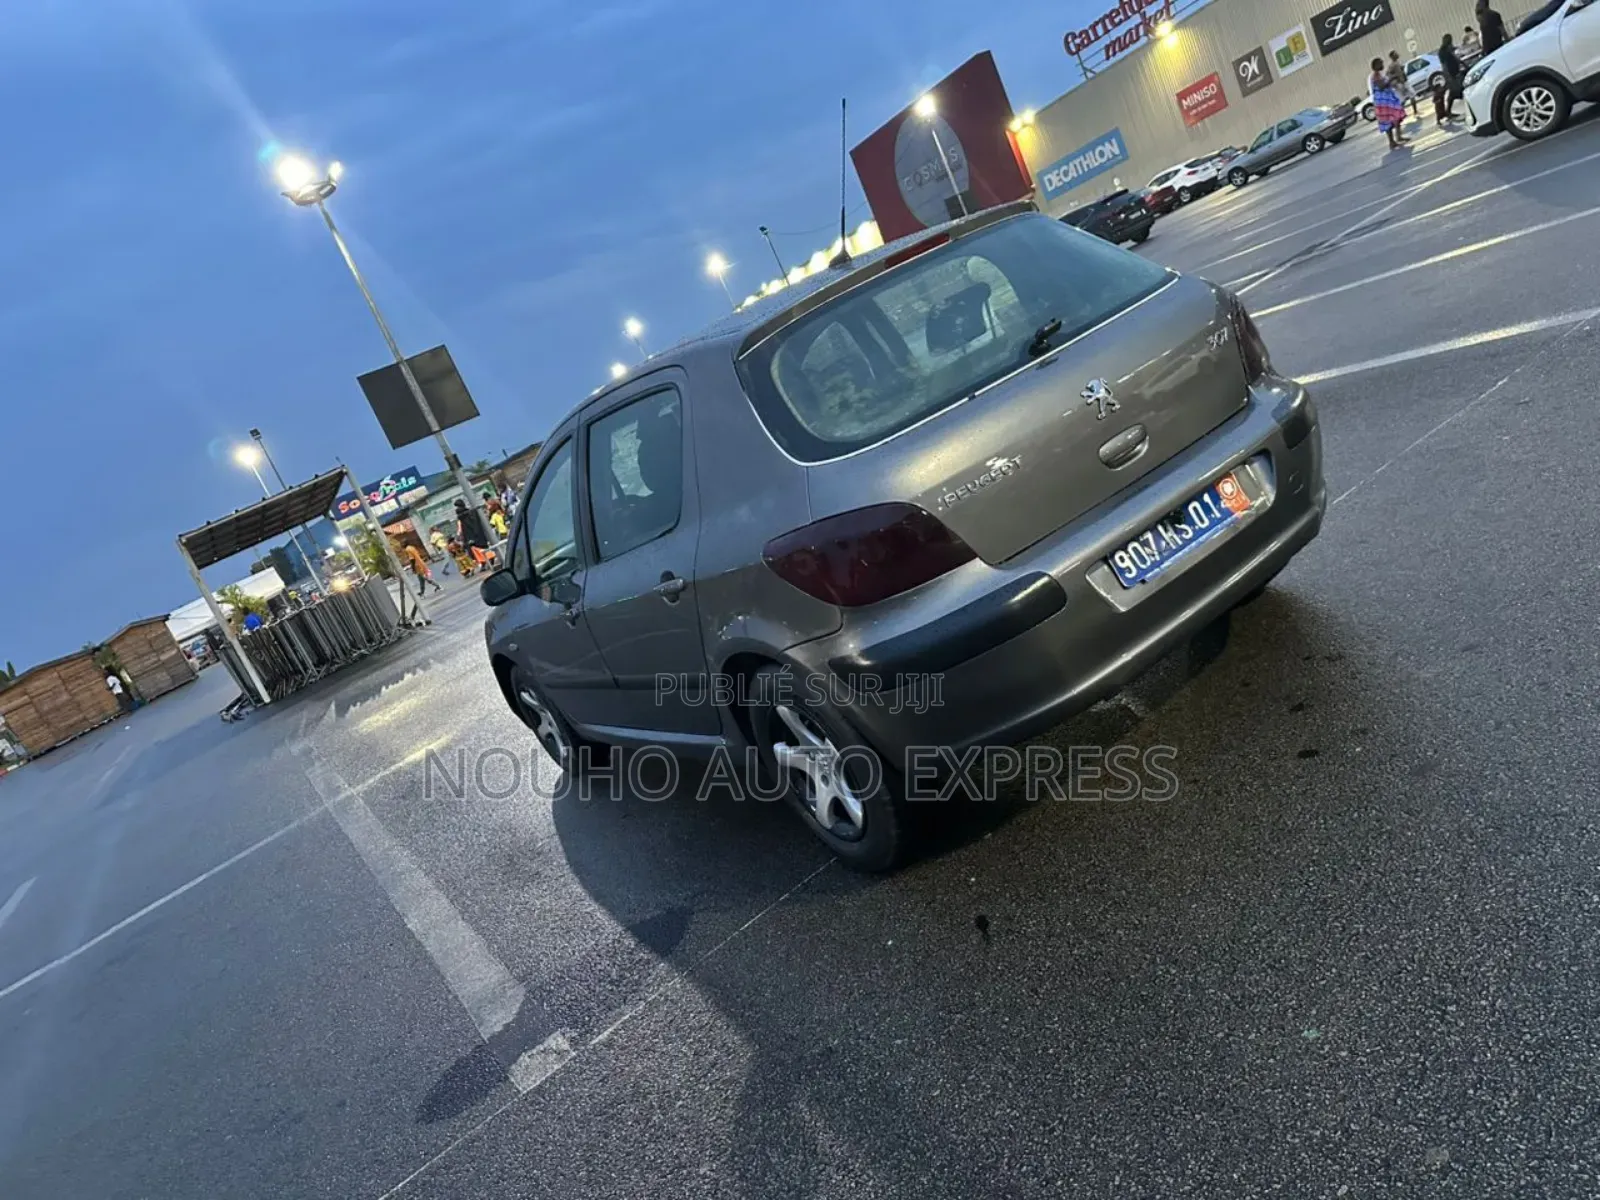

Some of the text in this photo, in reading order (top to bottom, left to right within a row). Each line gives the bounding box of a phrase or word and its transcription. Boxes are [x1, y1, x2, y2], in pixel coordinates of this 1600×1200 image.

[1323, 4, 1384, 46] Zino
[1181, 83, 1218, 110] MINISO
[903, 146, 960, 192] COSMS
[1043, 137, 1121, 193] DECATHLON
[943, 454, 1022, 509] PEUGEOT
